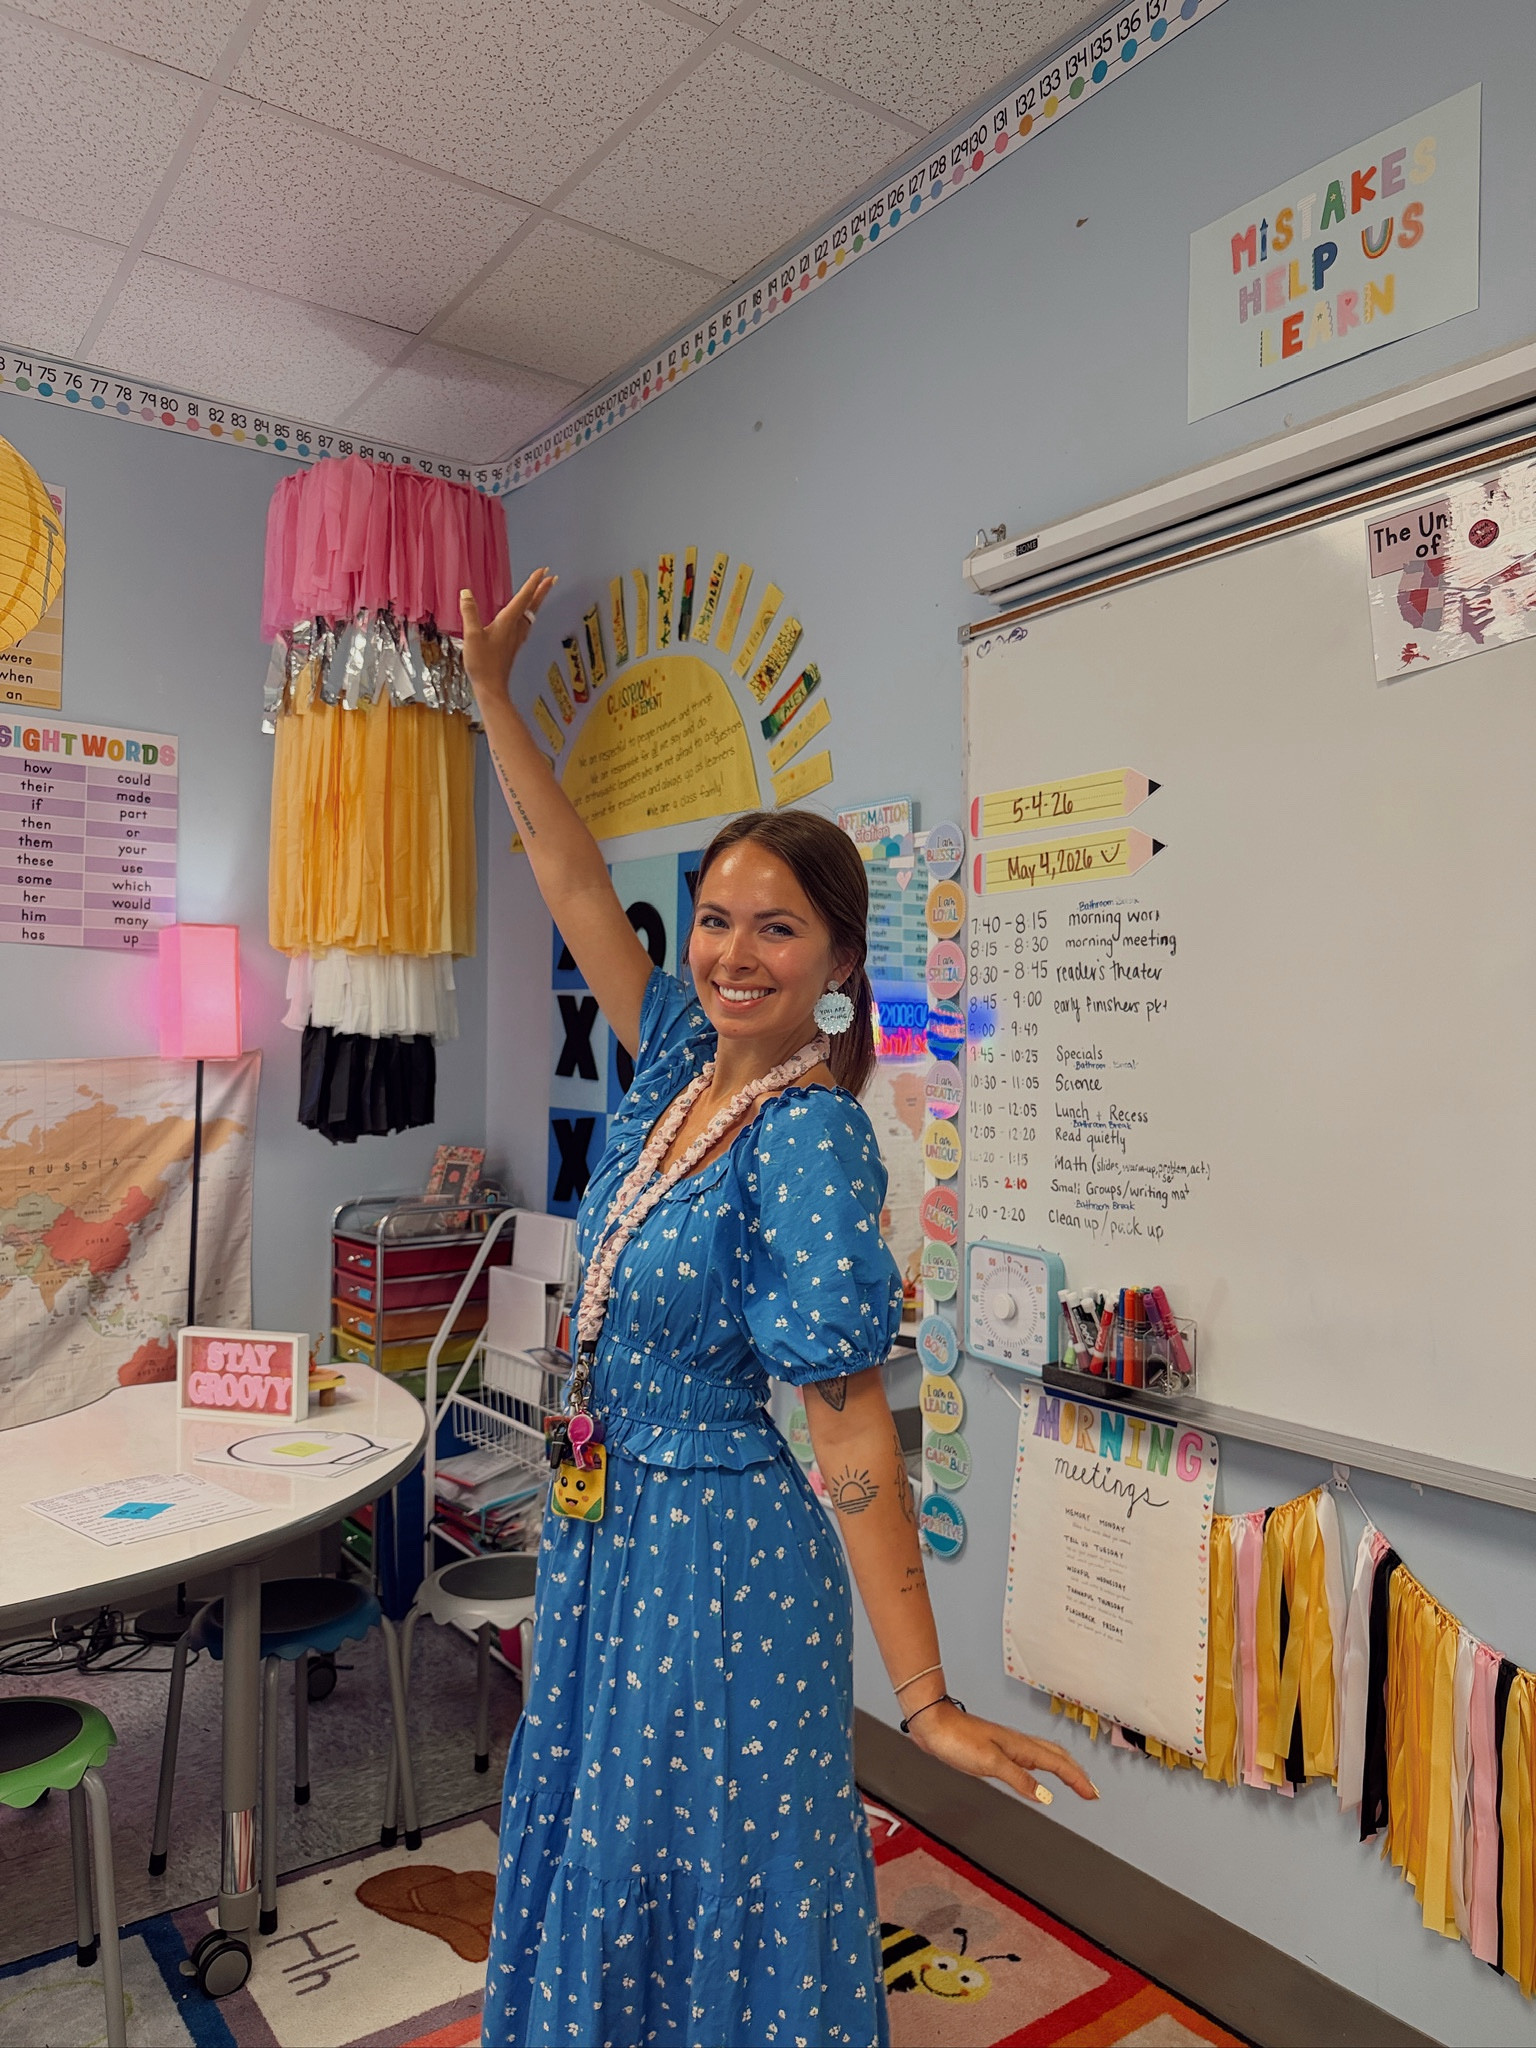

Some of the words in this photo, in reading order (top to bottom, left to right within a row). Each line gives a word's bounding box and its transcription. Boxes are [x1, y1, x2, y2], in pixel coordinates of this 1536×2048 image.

[851, 210, 867, 235] 124
[869, 198, 884, 222] 125
[887, 185, 904, 210] 126
[909, 169, 926, 196] 127
[929, 155, 947, 181] 128
[951, 141, 969, 167] 129
[969, 125, 988, 154] 130
[993, 110, 1008, 134] 131
[1015, 87, 1037, 118] 132
[1040, 68, 1061, 100] 133
[1066, 48, 1088, 80] 134
[1090, 29, 1113, 63] 135
[1117, 9, 1141, 43] 136
[1239, 241, 1339, 324] HELP
[1361, 201, 1424, 260] US
[1259, 273, 1396, 368] LEARN
[13, 359, 33, 377] 74
[38, 365, 57, 383] 75
[63, 371, 83, 389] 76
[89, 378, 109, 395] 77
[114, 384, 132, 401] 78
[139, 391, 157, 408] 79
[160, 397, 179, 412] 80
[188, 402, 199, 417] 81
[208, 408, 225, 424] 82
[231, 413, 247, 428] 83
[254, 418, 270, 434] 84
[274, 423, 290, 439] 85
[296, 429, 312, 444] 86
[318, 435, 334, 449] 87
[438, 463, 452, 478] 93
[1017, 539, 1038, 556] HOME
[1373, 525, 1411, 553] The
[1415, 535, 1442, 559] of
[0, 654, 33, 666] were
[0, 669, 33, 684] when
[6, 691, 23, 701] an
[0, 725, 77, 756] SIGHT
[82, 734, 176, 767] WORDS
[24, 760, 52, 775] how
[20, 779, 55, 793] their
[117, 774, 151, 787] could
[31, 799, 43, 811] if
[116, 792, 151, 804] made
[21, 817, 52, 830] then
[119, 809, 148, 822] part
[838, 803, 909, 831] AFFIRMATION
[18, 835, 53, 849] them
[126, 829, 141, 838] or
[855, 825, 890, 843] station
[118, 844, 147, 857] your
[17, 853, 54, 867] these
[121, 864, 143, 874] use
[1007, 857, 1036, 886] May
[17, 874, 53, 886] some
[112, 880, 152, 892] which
[23, 891, 46, 903] her
[112, 898, 151, 910] would
[21, 909, 47, 922] him
[114, 915, 149, 929] many
[932, 908, 958, 922] LOYAL
[971, 915, 1001, 934] 7:40
[1015, 910, 1047, 935] 8:15
[1069, 910, 1121, 941] morning
[22, 928, 45, 941] has
[123, 934, 139, 947] up
[970, 940, 998, 958] 8:15
[1014, 936, 1048, 954] 8:30
[1065, 934, 1114, 959] morning
[1122, 929, 1177, 957] meeting
[929, 967, 963, 982] SPECIAL
[970, 965, 998, 986] 8:30
[1014, 960, 1048, 981] 8:45
[1109, 960, 1163, 981] theater
[1053, 997, 1081, 1022] early
[1011, 1048, 1039, 1064] 10:25
[1056, 1043, 1103, 1066] Specials
[970, 1074, 997, 1090] 10:30
[1012, 1075, 1040, 1090] 11:05
[1055, 1073, 1103, 1092] Science
[926, 1085, 960, 1102] CREATIVE
[1008, 1102, 1038, 1118] 12:05
[1055, 1100, 1090, 1121] Lunch
[1109, 1104, 1149, 1124] Recess
[1055, 1127, 1081, 1142] Read
[1086, 1130, 1126, 1154] quietly
[925, 1144, 958, 1163] UNIQUE
[28, 1157, 119, 1175] RUSSIA
[1054, 1154, 1088, 1173] Math
[1004, 1176, 1028, 1190] 2:10
[925, 1204, 958, 1234] HAPPY
[1000, 1206, 1026, 1222] 2:20
[1048, 1209, 1081, 1230] Clean
[922, 1265, 958, 1282] LISTENER
[207, 1341, 278, 1375] STAY
[1003, 1350, 1012, 1359] 30
[188, 1371, 293, 1412] GROOVY
[923, 1397, 959, 1416] LEADER
[1033, 1396, 1203, 1482] MORNING
[925, 1447, 969, 1477] CAPABLE
[1055, 1457, 1170, 1519] meetings
[1099, 1519, 1126, 1534] MONDAY
[1094, 1543, 1124, 1560] TUESDAY
[1102, 1620, 1124, 1636] FRIDAY
